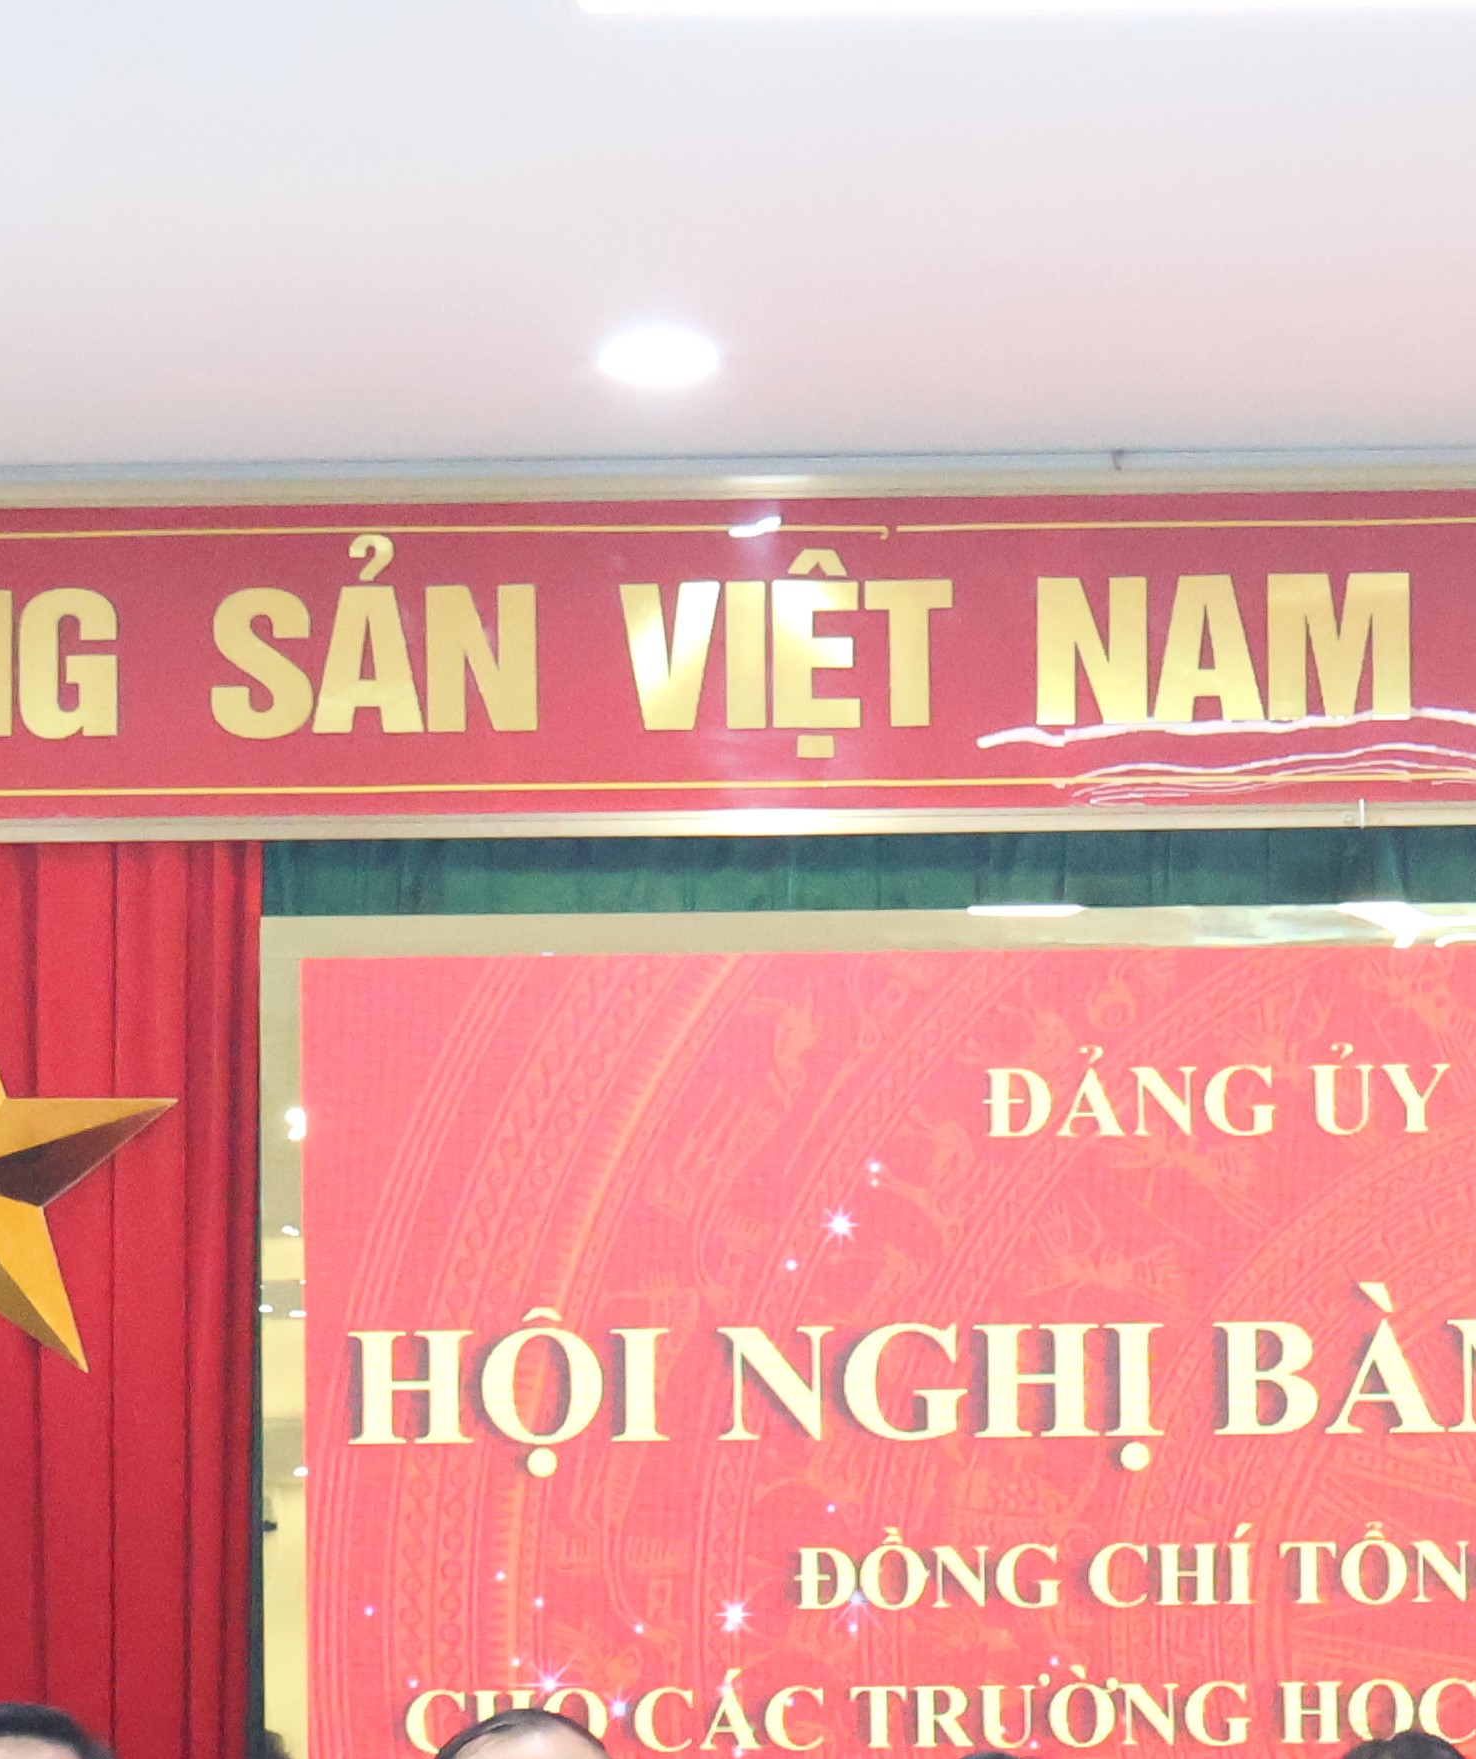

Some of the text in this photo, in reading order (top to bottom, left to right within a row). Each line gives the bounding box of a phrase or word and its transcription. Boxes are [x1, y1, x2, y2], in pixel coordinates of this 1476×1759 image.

[210, 532, 538, 738] SẢN
[620, 548, 953, 759] VIỆT
[1036, 572, 1412, 725] NAM
[985, 1046, 1277, 1139] ĐẢNG
[1311, 1044, 1454, 1137] ỦY
[347, 1305, 670, 1479] HỘI
[719, 1321, 1167, 1473] NGHỊ
[795, 1526, 1059, 1611] ĐỒNG
[1089, 1522, 1257, 1608] CHÍ
[633, 1668, 826, 1752] CÁC
[851, 1664, 1251, 1750] TRƯỜNG
